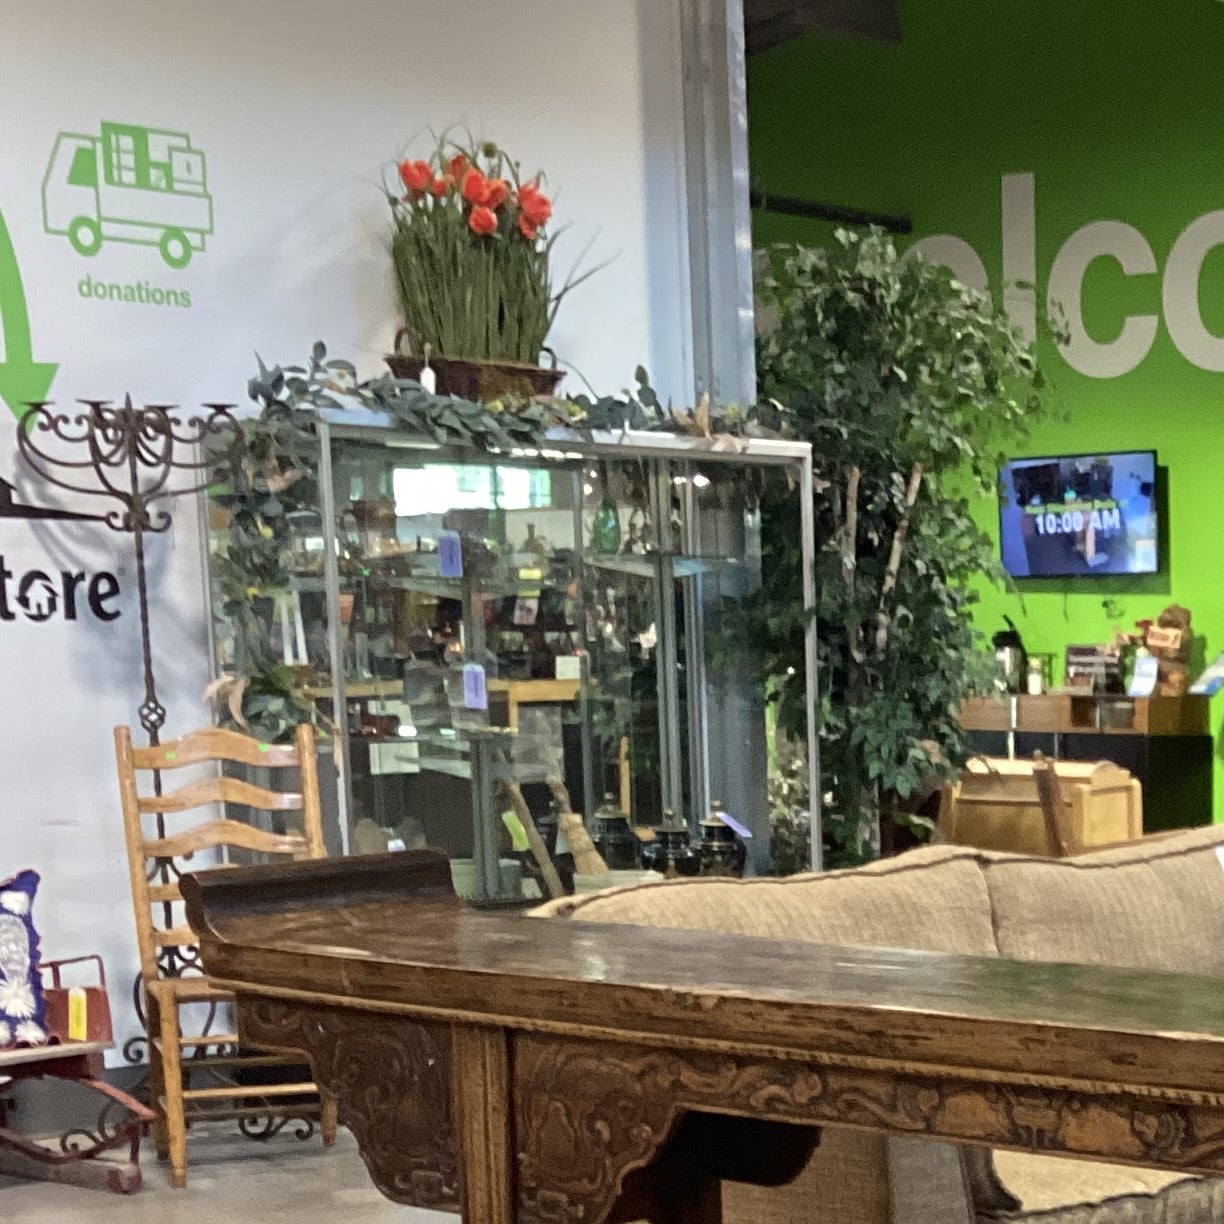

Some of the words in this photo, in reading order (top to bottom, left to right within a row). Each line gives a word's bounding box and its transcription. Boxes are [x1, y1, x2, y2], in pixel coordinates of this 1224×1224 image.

[77, 273, 192, 309] donations
[1036, 510, 1083, 536] 10:00
[1089, 508, 1120, 530] AM
